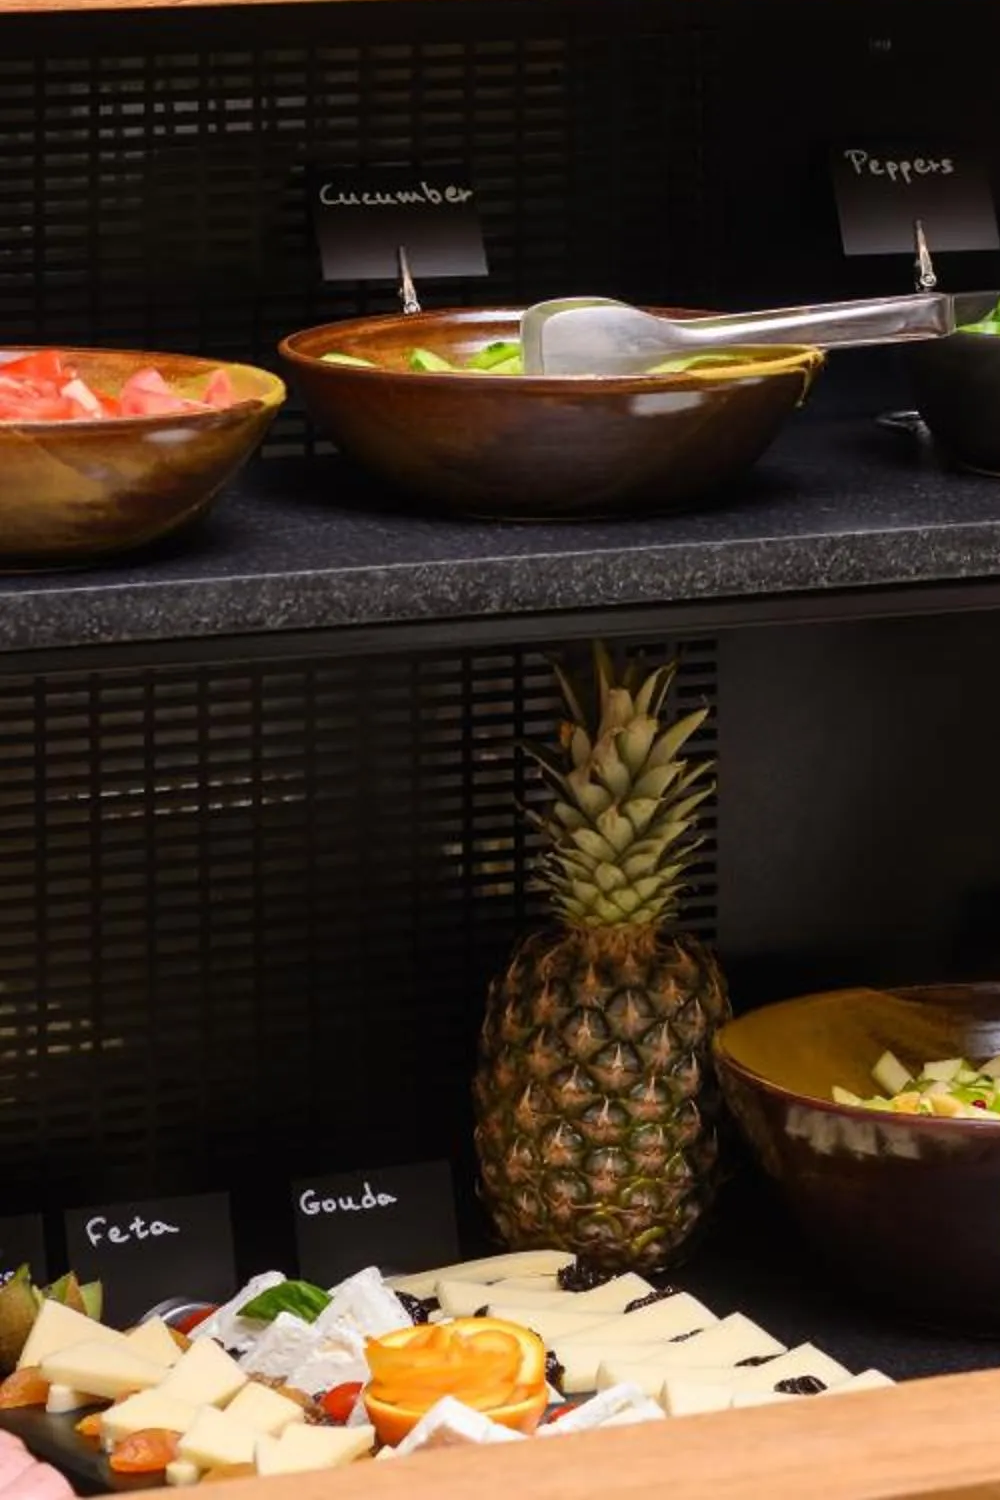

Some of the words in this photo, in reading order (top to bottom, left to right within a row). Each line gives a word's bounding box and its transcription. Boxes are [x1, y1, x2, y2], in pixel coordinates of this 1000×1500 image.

[844, 149, 955, 184] Peppers
[319, 181, 474, 205] Cucumber
[299, 1181, 398, 1216] Gouda
[85, 1215, 180, 1247] Feta
